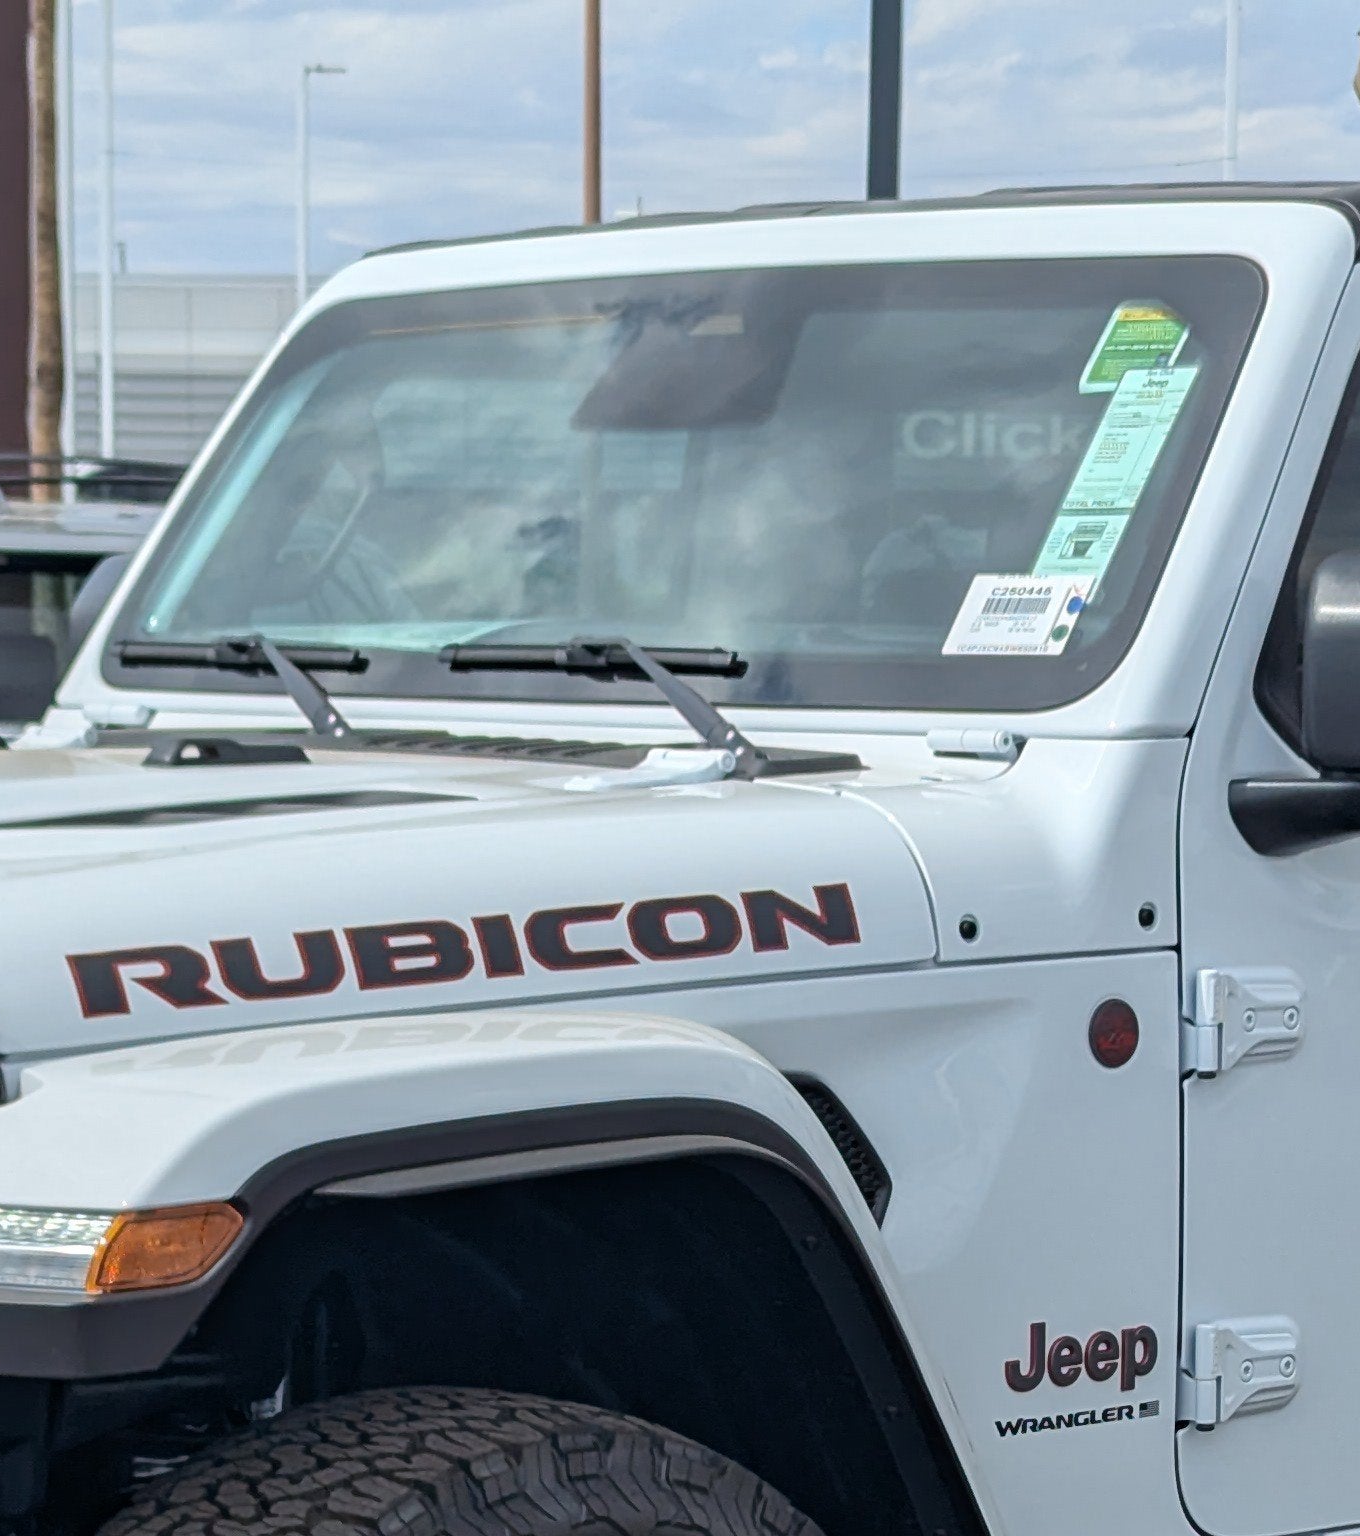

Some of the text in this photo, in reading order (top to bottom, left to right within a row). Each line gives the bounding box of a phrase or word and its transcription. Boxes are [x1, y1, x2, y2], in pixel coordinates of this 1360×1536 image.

[65, 882, 861, 1019] RUBICON
[1004, 1321, 1158, 1393] Jeep
[995, 1404, 1135, 1437] WRANGLER
